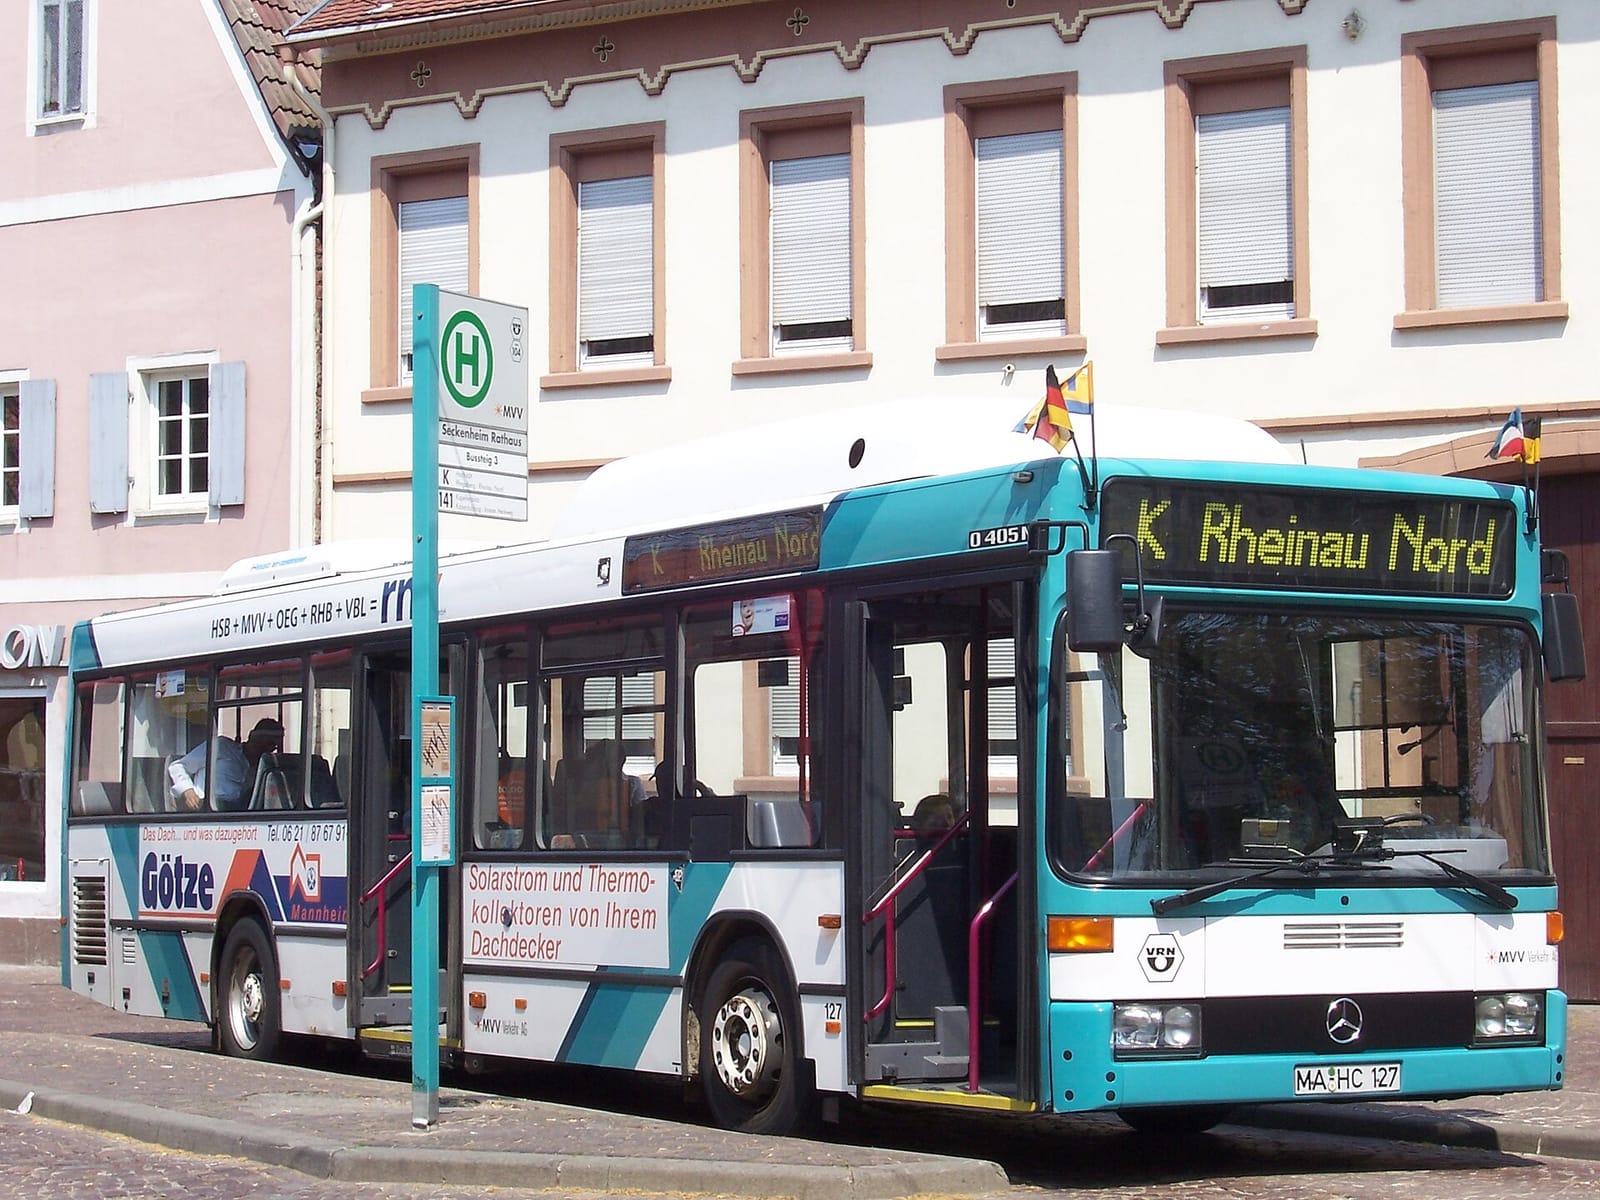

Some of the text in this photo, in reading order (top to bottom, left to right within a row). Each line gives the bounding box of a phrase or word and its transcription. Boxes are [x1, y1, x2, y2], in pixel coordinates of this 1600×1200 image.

[456, 332, 479, 386] H
[503, 405, 524, 420] MVV
[442, 423, 522, 447] Seckenheim Rathaus
[466, 452, 498, 466] Bussteig 3
[442, 469, 450, 485] K
[439, 491, 453, 508] 141
[651, 514, 820, 576] K Rheinau Nord
[984, 527, 1019, 546] 405
[1136, 498, 1496, 575] K Rheinau Nord
[211, 616, 230, 639] HSB
[241, 611, 266, 635] MVV
[276, 607, 298, 630] OEG
[310, 601, 332, 625] RHB
[346, 597, 366, 620] VBL
[143, 826, 156, 840] Das
[184, 826, 197, 840] und
[200, 828, 214, 840] was
[268, 824, 280, 842] Tel.
[142, 851, 214, 910] Götze
[470, 864, 656, 893] Solarstrom und Thermo-
[569, 907, 599, 928] von
[605, 902, 657, 930] Ihrem
[471, 930, 562, 960] Dachdecker
[1146, 947, 1176, 956] VRN
[1498, 950, 1525, 963] MVV
[824, 1002, 842, 1020] 127
[482, 1018, 501, 1034] MVV
[1371, 1066, 1398, 1088] 127
